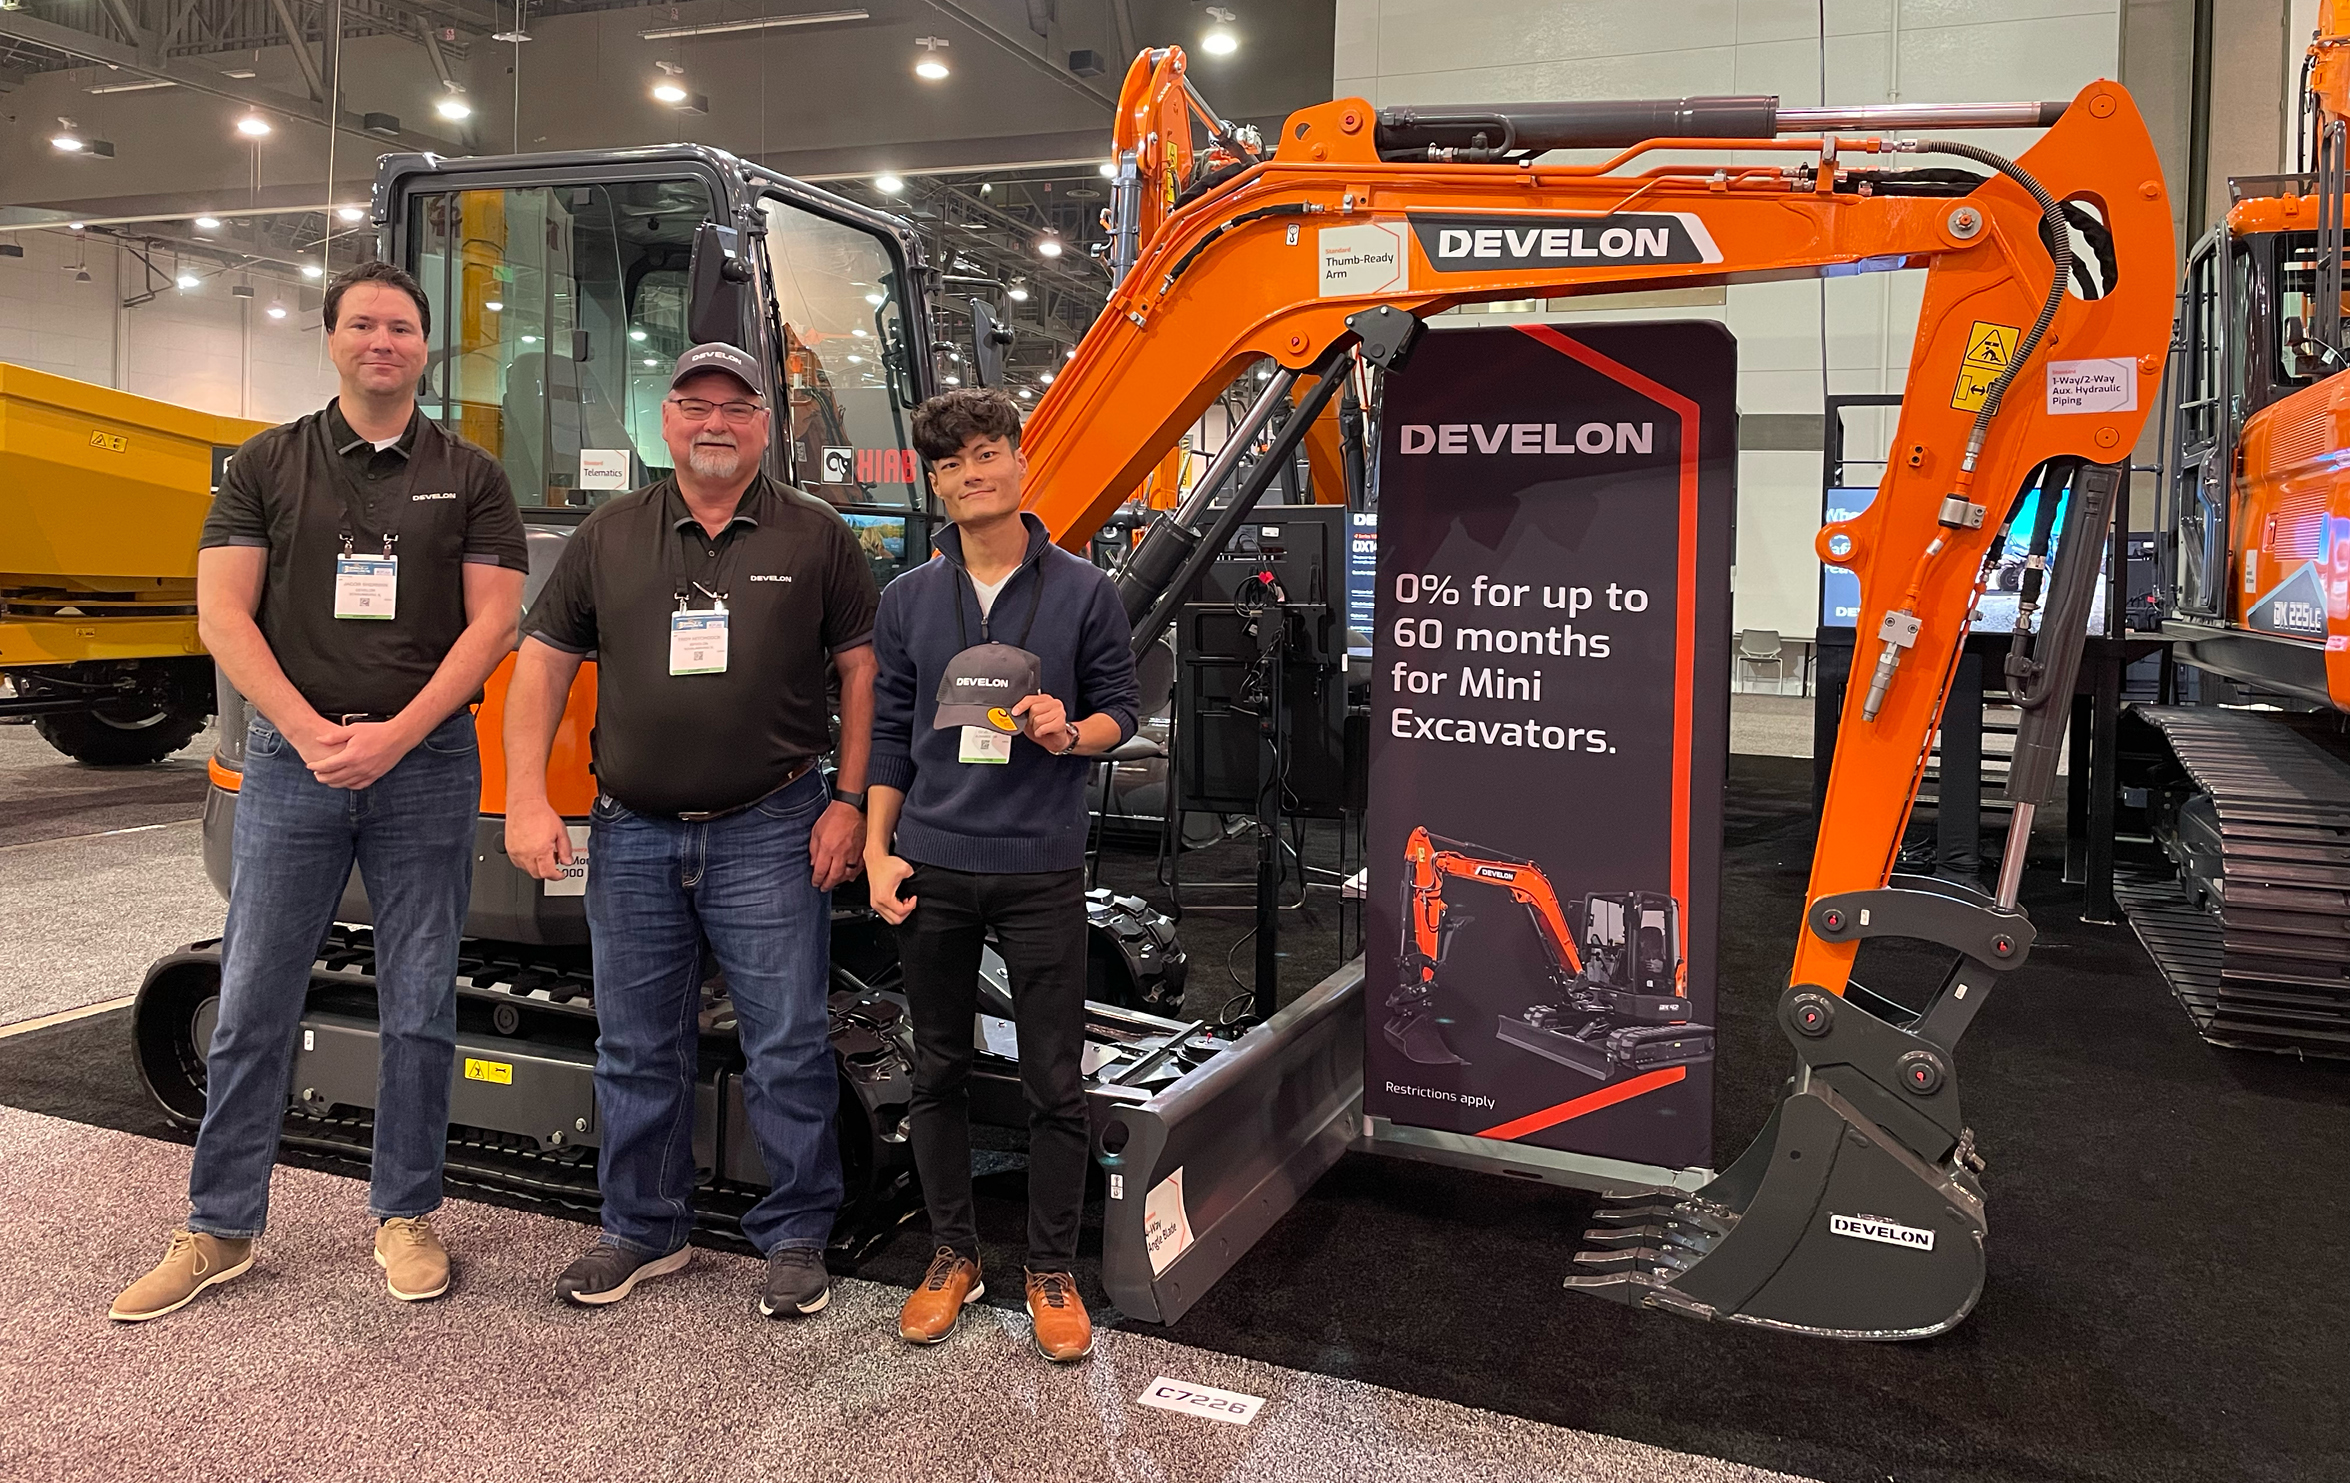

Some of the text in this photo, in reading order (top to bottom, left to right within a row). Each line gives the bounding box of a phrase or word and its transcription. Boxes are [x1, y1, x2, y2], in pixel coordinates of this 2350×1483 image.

[1438, 228, 1670, 258] DEVELON
[1326, 252, 1394, 266] Thumb-Ready
[1326, 270, 1347, 279] Arm
[691, 351, 742, 365] DEVELON
[2052, 375, 2115, 386] 1-Way/2-Way
[2052, 384, 2121, 395] Aux. Hydraulic
[2052, 397, 2082, 406] Piping
[1400, 422, 1653, 454] DEVELON
[584, 468, 623, 477] Telematics
[857, 449, 917, 483] HIAB
[412, 493, 456, 501] DEVELON
[1395, 573, 1648, 618] 0% for up to
[1394, 618, 1611, 658] 60 months
[956, 677, 1009, 688] DEVELON
[1391, 662, 1542, 701] for Mini
[1391, 708, 1616, 754] Excavators.
[1481, 868, 1514, 880] DEVELON
[1385, 1081, 1495, 1109] Restrictions apply
[1148, 1222, 1177, 1252] Angle Blade
[1835, 1219, 1929, 1245] DEVELON
[1155, 1387, 1248, 1414] C7226
